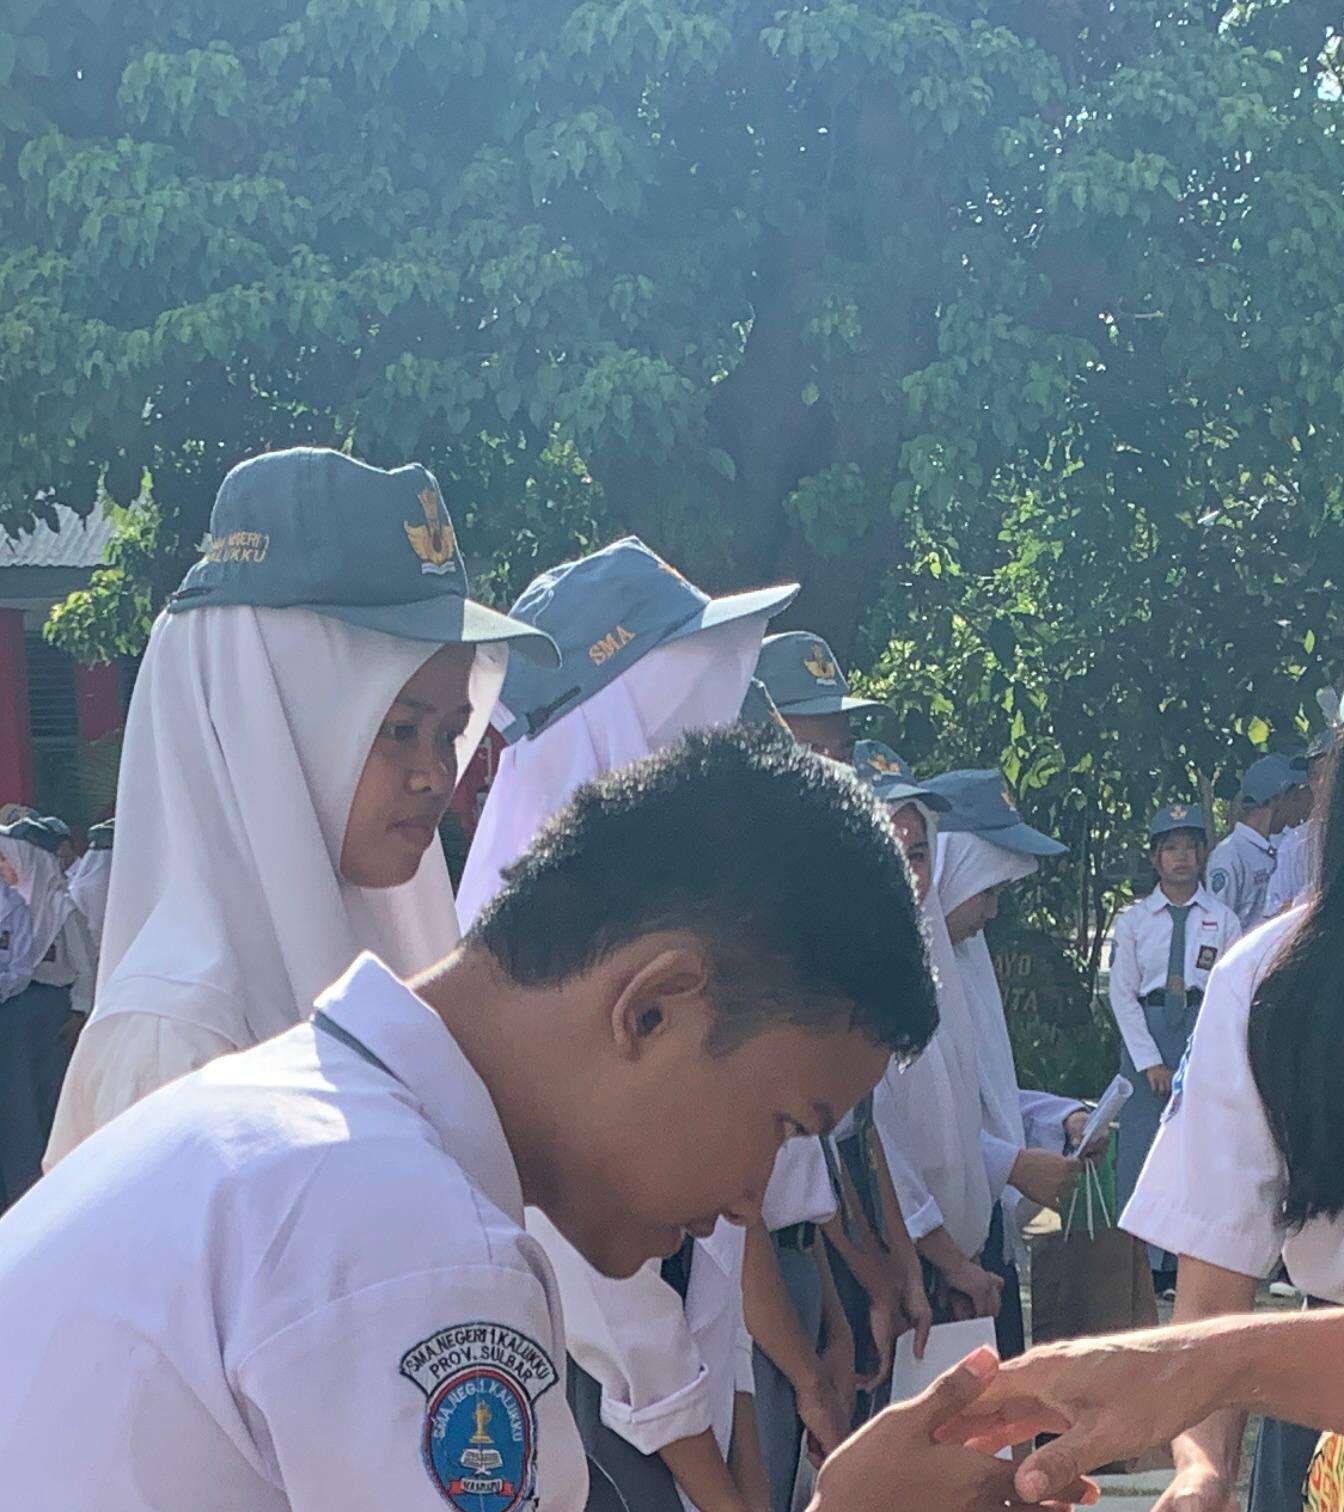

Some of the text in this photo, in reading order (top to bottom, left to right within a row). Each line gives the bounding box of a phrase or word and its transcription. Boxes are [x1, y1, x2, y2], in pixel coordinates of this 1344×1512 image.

[588, 625, 636, 666] SMA
[406, 1343, 437, 1372] SMA
[436, 1328, 487, 1353] NEGERI
[497, 1331, 550, 1380] KALUKKU
[429, 1346, 533, 1382] PROV. SULBAR
[488, 1380, 523, 1442] KALUKKU
